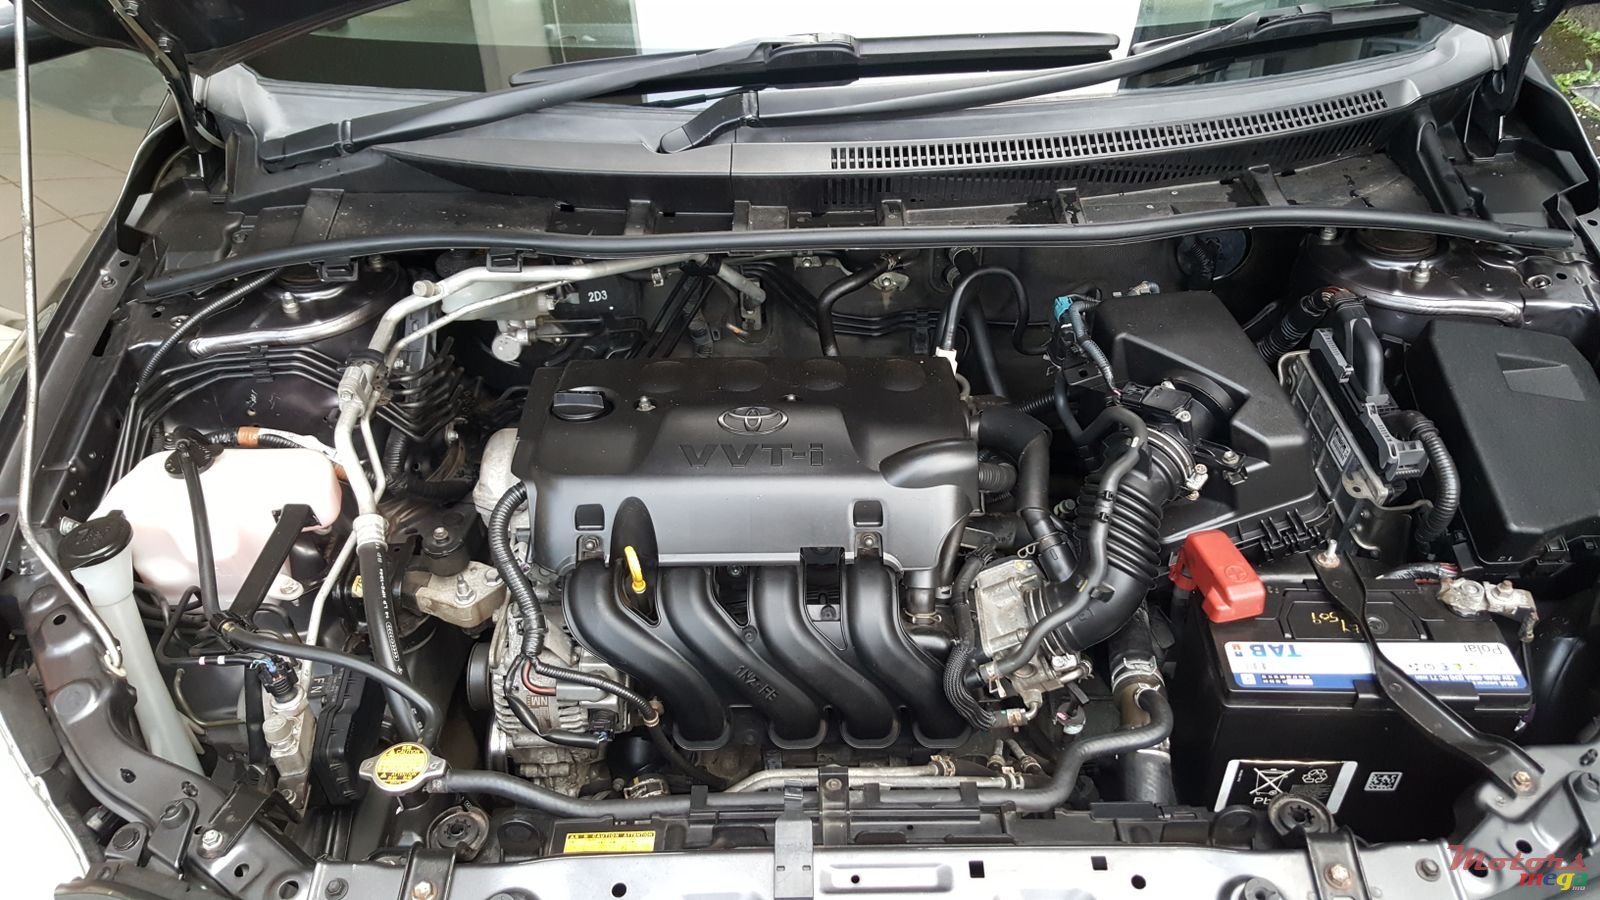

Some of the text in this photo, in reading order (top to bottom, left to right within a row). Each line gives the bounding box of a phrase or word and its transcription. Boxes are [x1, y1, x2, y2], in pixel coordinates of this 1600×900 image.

[588, 290, 608, 303] 2D3
[679, 443, 823, 468] VVT-i
[1249, 644, 1302, 657] TAB
[1463, 644, 1503, 655] Polar
[1253, 797, 1272, 805] Pb
